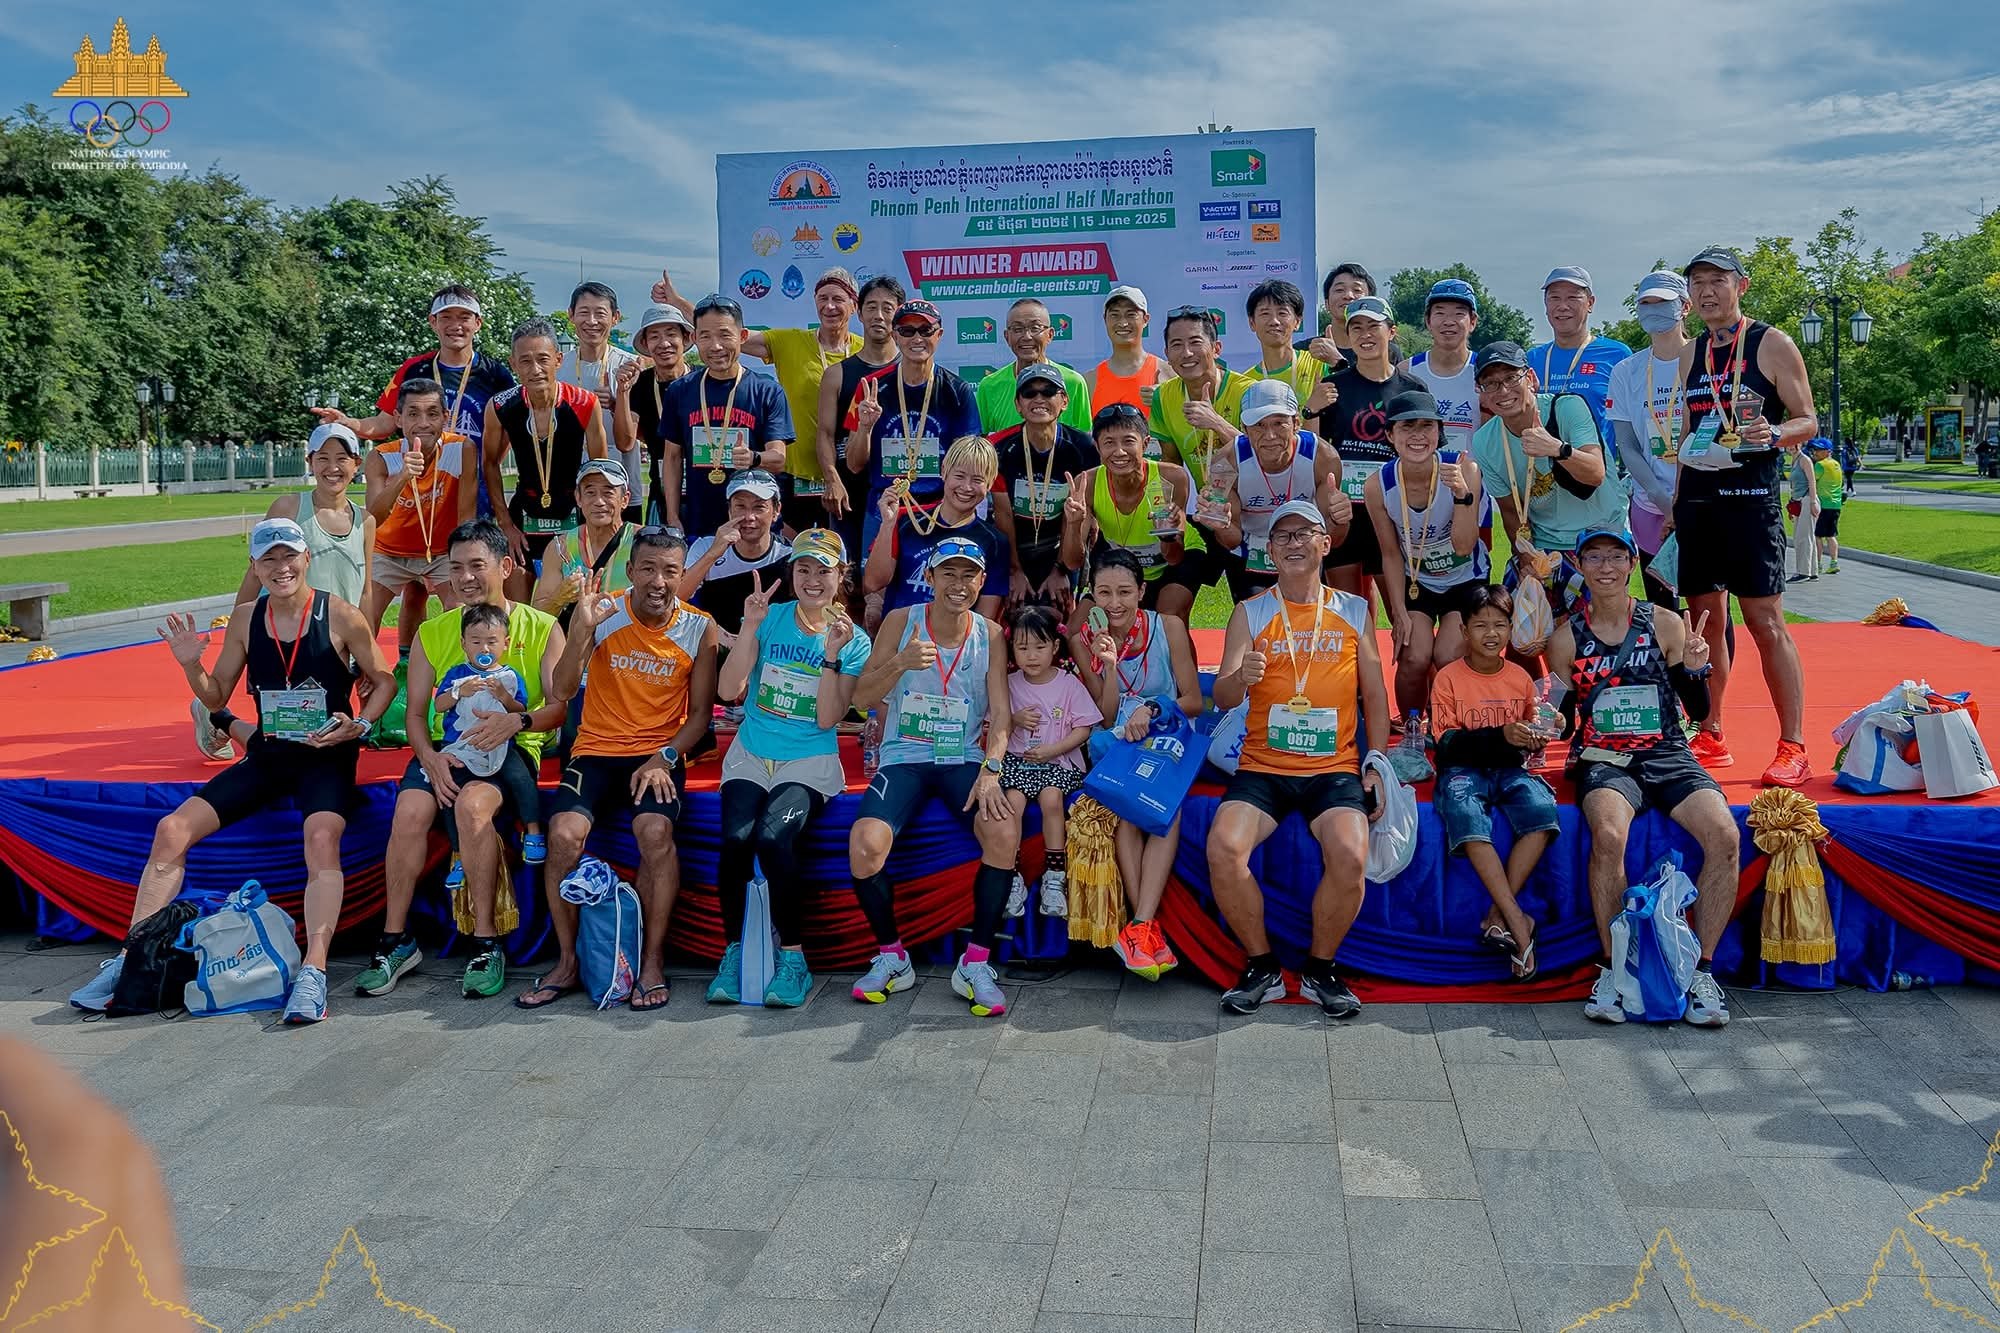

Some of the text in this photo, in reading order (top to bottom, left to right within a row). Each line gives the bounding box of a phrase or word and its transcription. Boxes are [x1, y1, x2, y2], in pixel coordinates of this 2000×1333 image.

[1216, 170, 1254, 182] Smart
[870, 187, 1174, 217] Phnom Penh International Half Marathon
[1258, 203, 1279, 212] FTB
[1080, 215, 1094, 227] 15
[1099, 213, 1131, 226] June
[1135, 212, 1167, 225] 2025
[1206, 229, 1240, 240] HI-TECH
[921, 249, 1098, 276] WINNER AWARD
[931, 279, 1100, 297] www.cambodia-events.org
[961, 331, 989, 340] Smart
[713, 406, 756, 430] MAATHON
[1322, 629, 1344, 638] PENH
[610, 653, 675, 677] SOYUKAI
[772, 693, 798, 710] 1061
[1612, 711, 1642, 726] 0742
[1152, 736, 1185, 758] FTB
[1287, 732, 1318, 747] 0879
